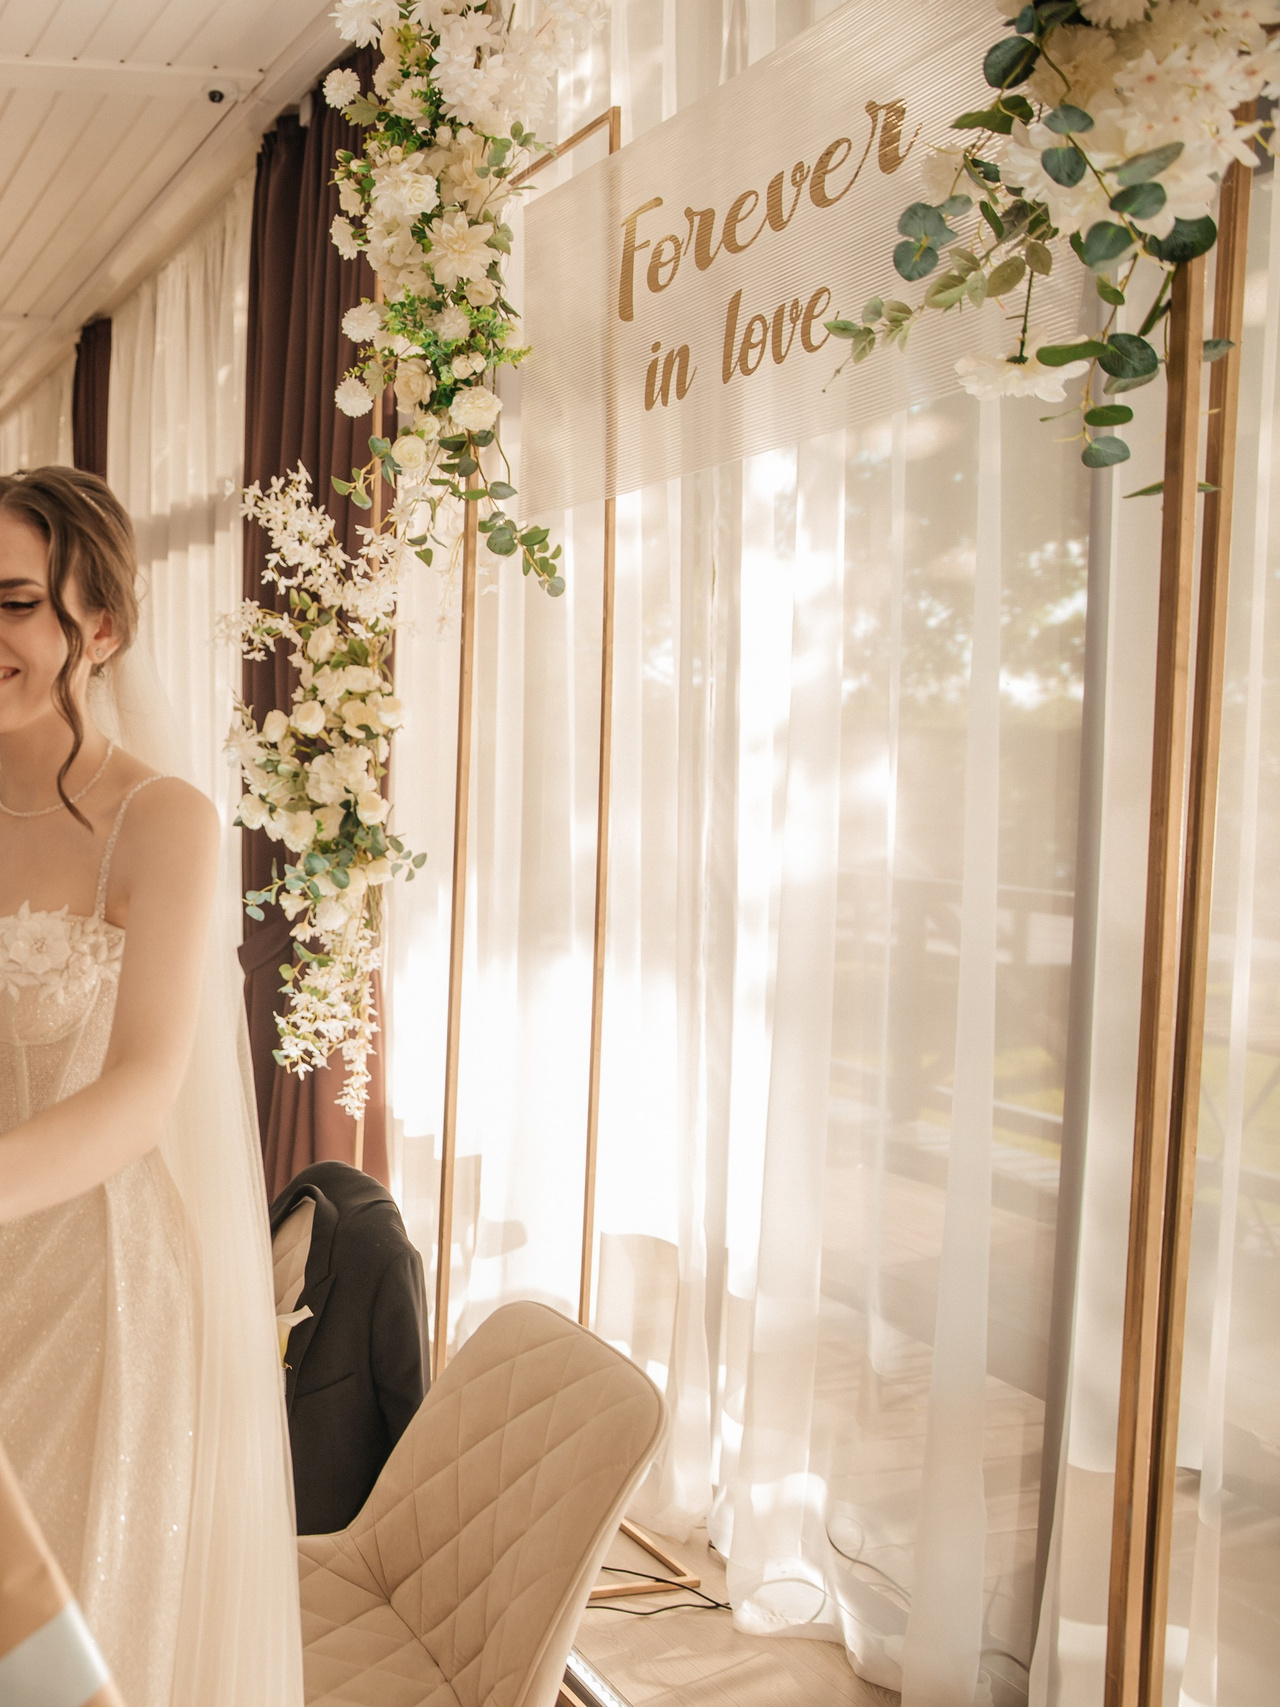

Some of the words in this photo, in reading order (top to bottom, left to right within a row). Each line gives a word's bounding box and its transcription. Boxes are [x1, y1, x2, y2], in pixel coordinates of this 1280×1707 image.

[618, 98, 922, 322] Forever
[644, 341, 698, 412] in
[721, 286, 840, 385] love
